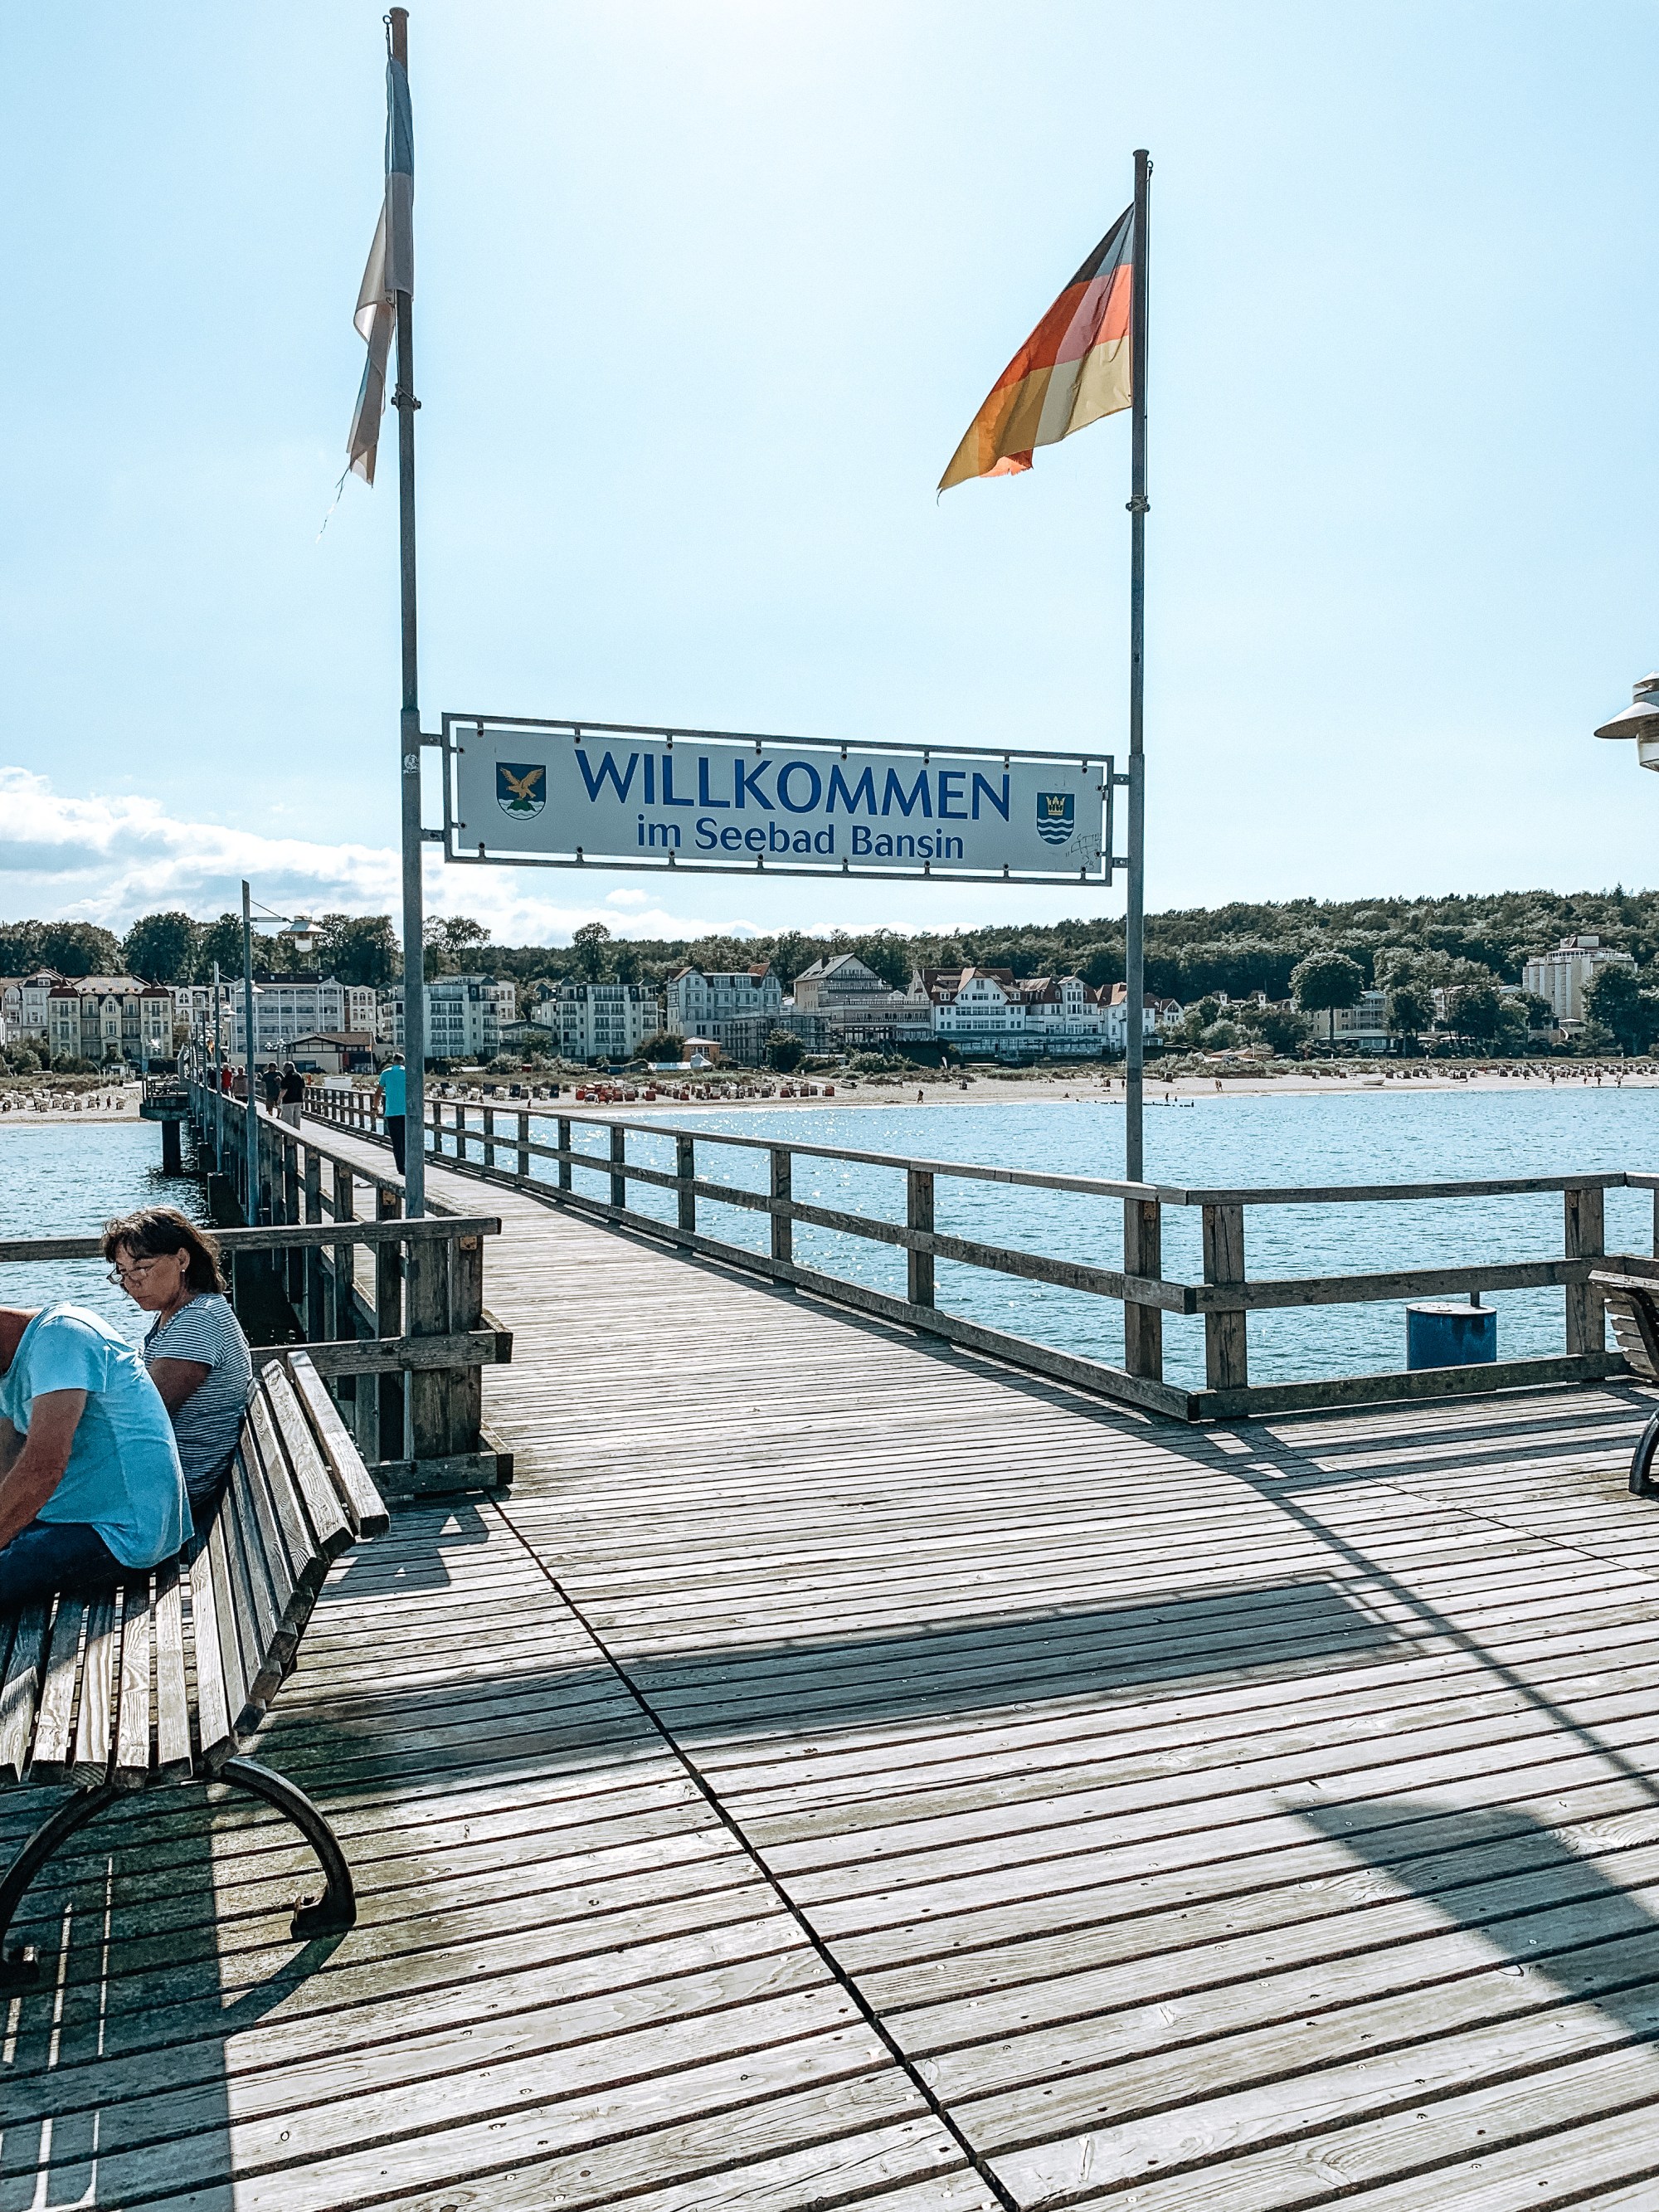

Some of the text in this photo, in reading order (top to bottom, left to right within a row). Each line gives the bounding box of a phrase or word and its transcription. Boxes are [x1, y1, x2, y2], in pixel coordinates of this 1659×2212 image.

[574, 748, 1010, 821] WILLKOMMEN
[637, 814, 963, 860] im Seebad Bansin
